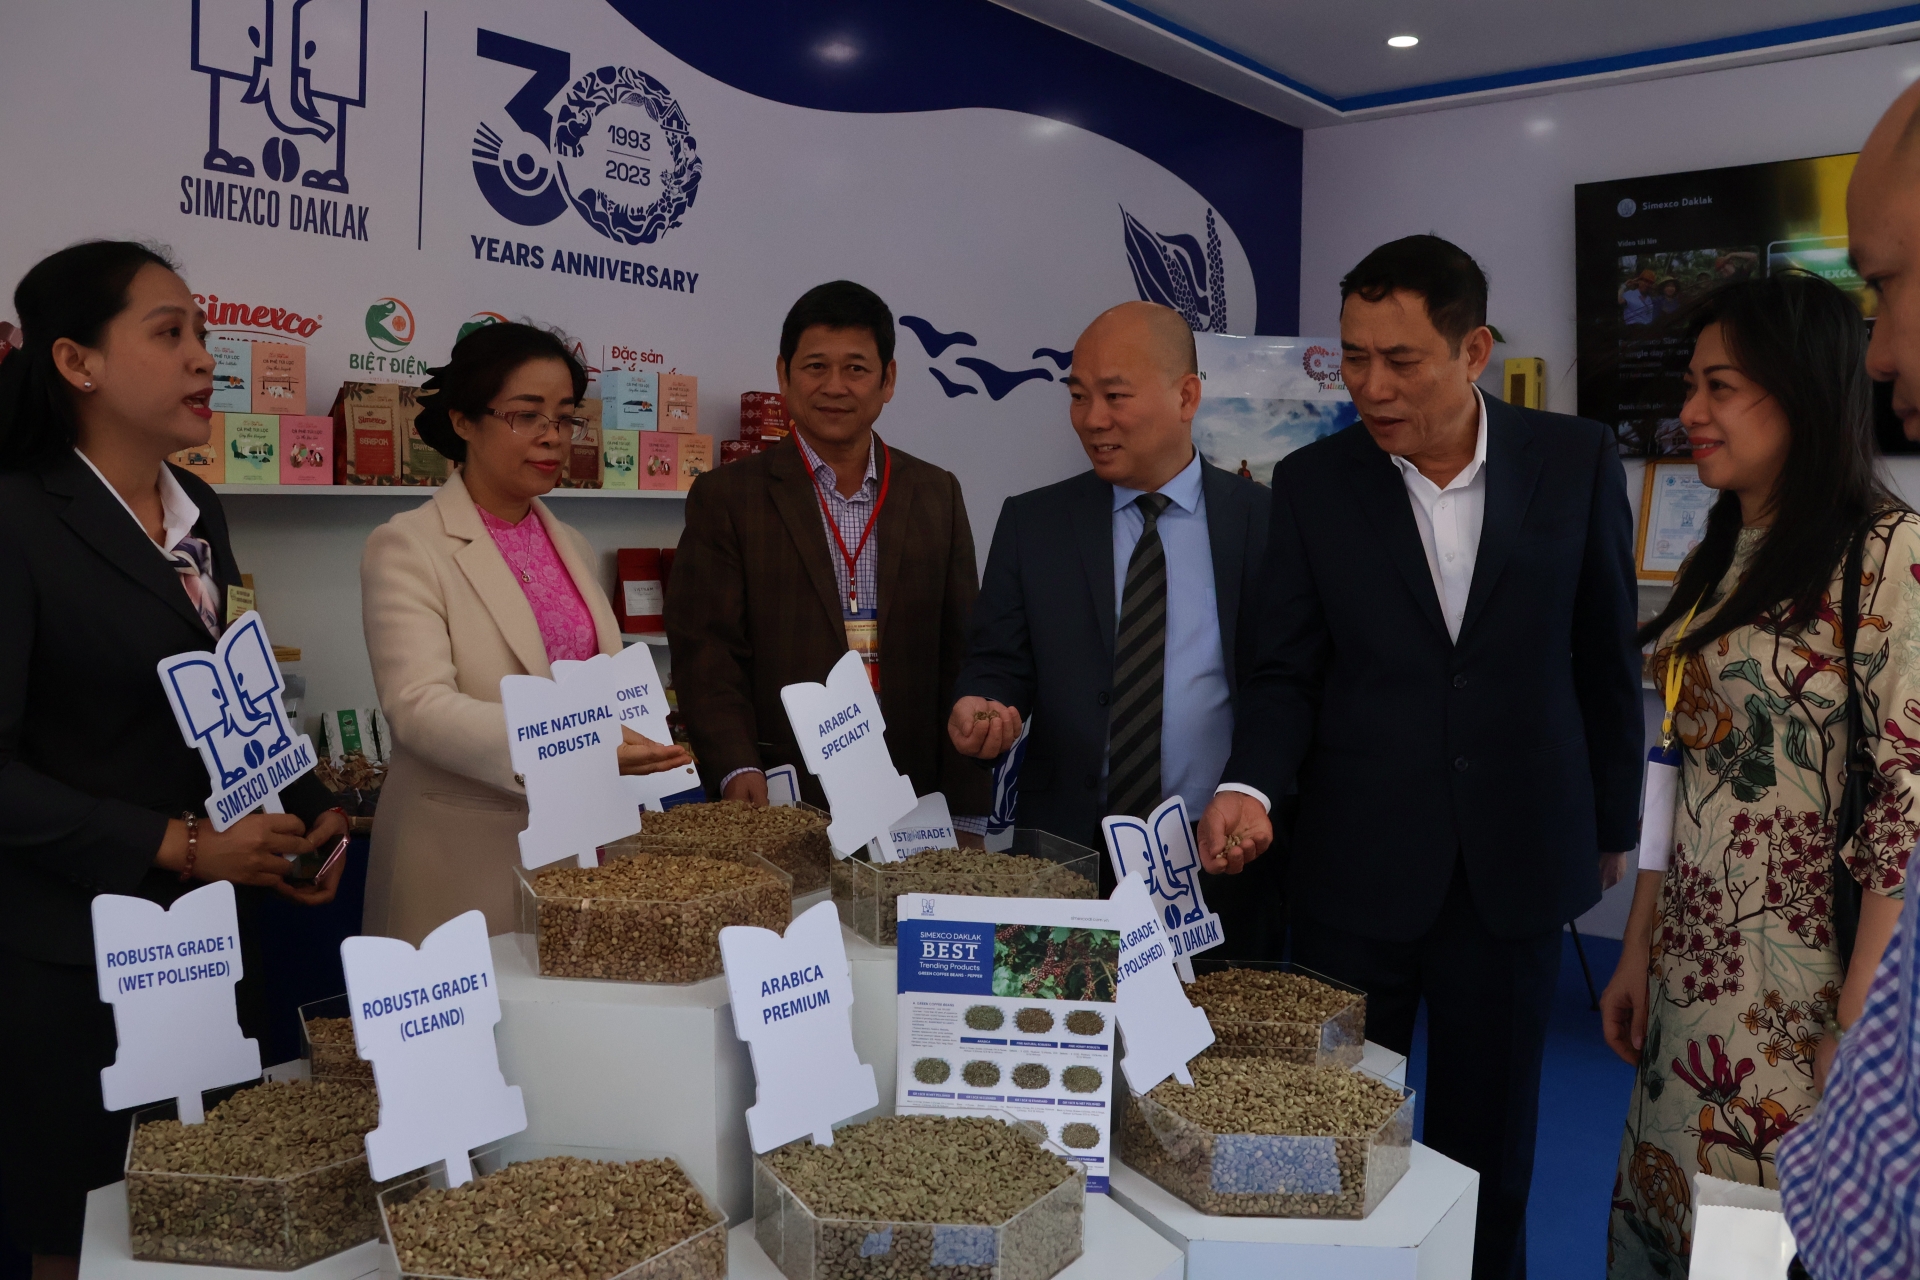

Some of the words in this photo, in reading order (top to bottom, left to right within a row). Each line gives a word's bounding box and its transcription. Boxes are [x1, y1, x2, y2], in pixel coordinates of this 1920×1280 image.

[607, 125, 651, 151] 1993
[605, 160, 651, 186] 2023
[180, 175, 280, 228] SIMEXCO
[289, 194, 370, 242] DAKLAK
[1642, 201, 1679, 211] Simexco
[1681, 195, 1713, 207] Daklak
[470, 234, 544, 269] YEARS
[551, 249, 699, 294] ANNIVERSARY
[349, 351, 387, 374] BIỆT
[389, 355, 427, 378] ĐIỆN
[612, 346, 637, 364] Đặc
[640, 349, 664, 364] sản
[358, 415, 387, 425] Simexco
[360, 438, 389, 446] SEREPOK
[616, 684, 649, 702] ONEY
[517, 721, 549, 742] FINE
[551, 705, 613, 733] NATURAL
[619, 704, 649, 721] USTA
[818, 703, 861, 738] ARABICA
[537, 731, 601, 760] ROBUSTA
[821, 719, 870, 760] SPECIALTY
[216, 772, 269, 824] SIMEXCO
[267, 743, 311, 788] DAKLAK
[946, 827, 952, 837] 1
[920, 931, 952, 939] SIMEXCO
[953, 933, 982, 941] DAKLAK
[1128, 922, 1156, 949] GRADE
[1153, 918, 1160, 932] 1
[1182, 920, 1220, 952] DAKLAK
[107, 944, 174, 968] ROBUSTA
[177, 936, 225, 957] GRADE
[227, 935, 234, 949] 1
[919, 961, 949, 971] Trending
[950, 963, 980, 971] Products
[922, 942, 978, 960] BEST
[1127, 941, 1166, 978] POLISHED)
[118, 972, 154, 994] (WET
[157, 960, 230, 986] POLISHED)
[761, 964, 824, 997] ARABICA
[362, 988, 430, 1020] ROBUSTA
[432, 974, 479, 1000] GRADE
[481, 972, 488, 987] 1
[763, 989, 830, 1025] PREMIUM
[400, 1006, 465, 1042] (CLEAND)
